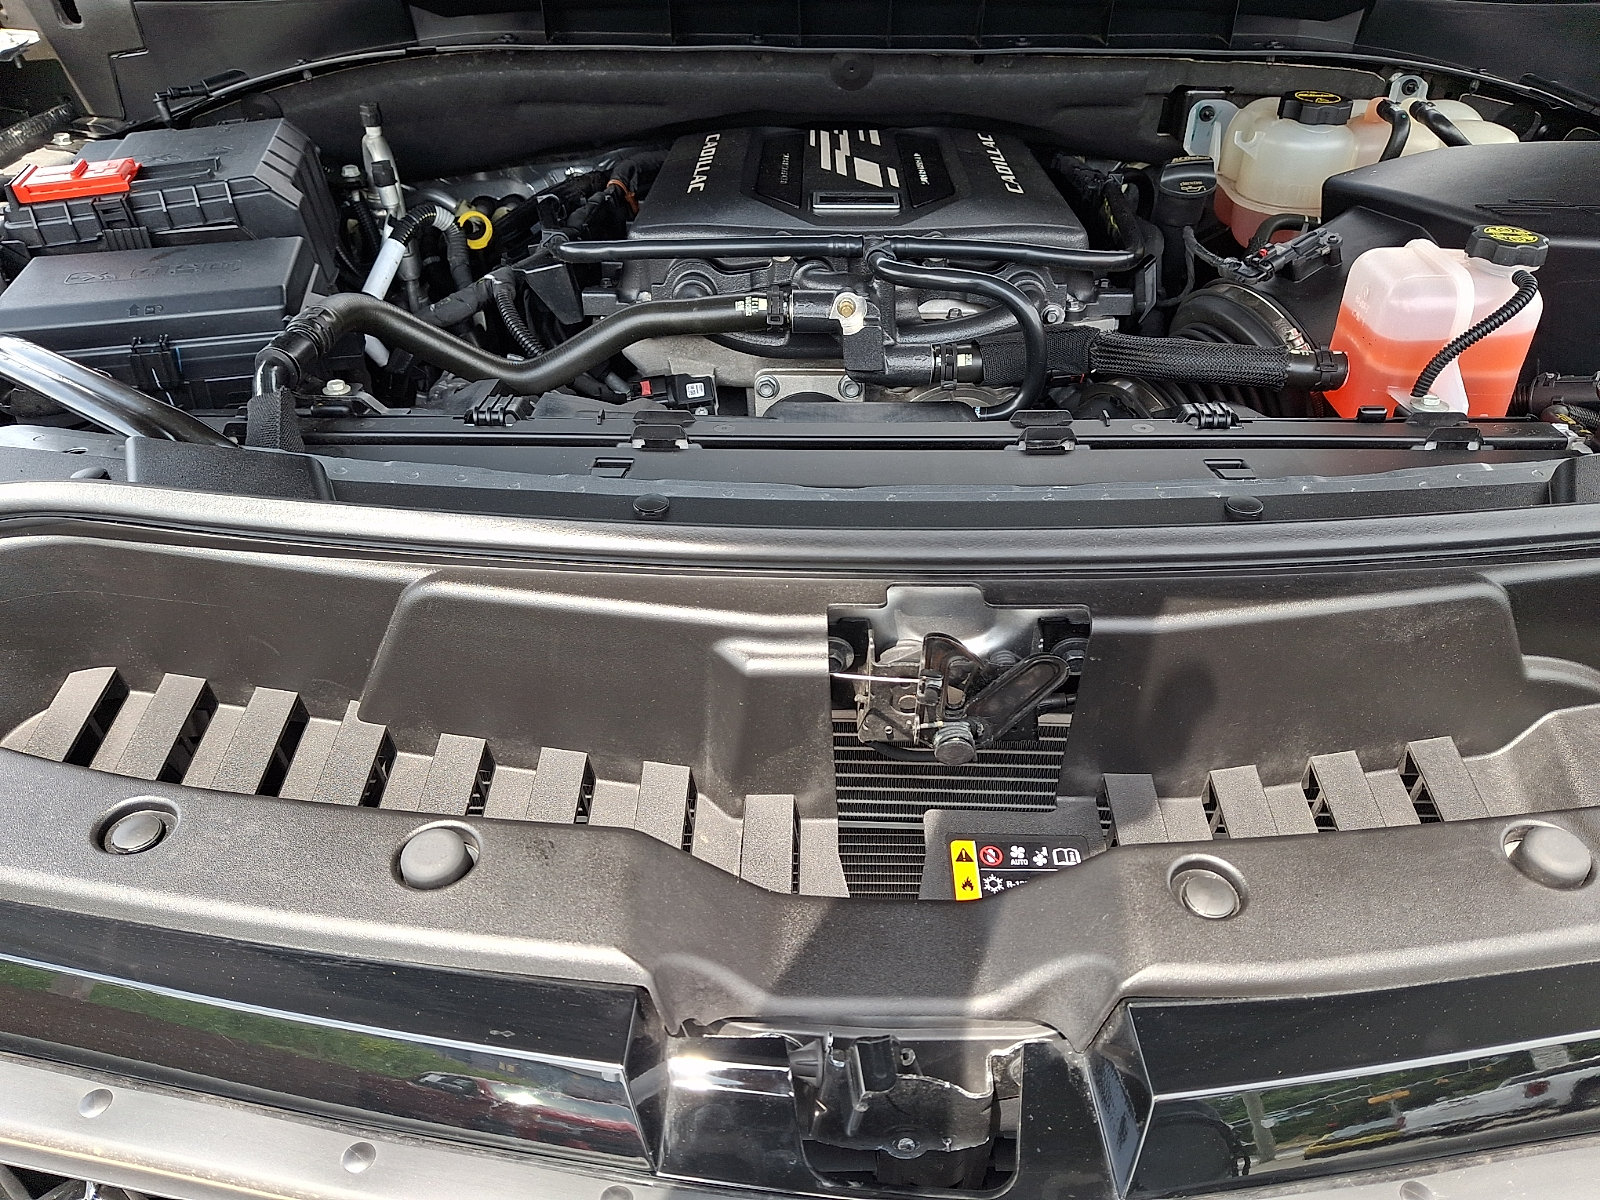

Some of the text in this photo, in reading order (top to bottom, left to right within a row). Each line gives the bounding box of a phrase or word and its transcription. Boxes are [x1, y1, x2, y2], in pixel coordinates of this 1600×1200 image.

[686, 133, 721, 194] CADILLAC
[976, 132, 1025, 194] CADILLAC
[1005, 880, 1028, 889] R-1
